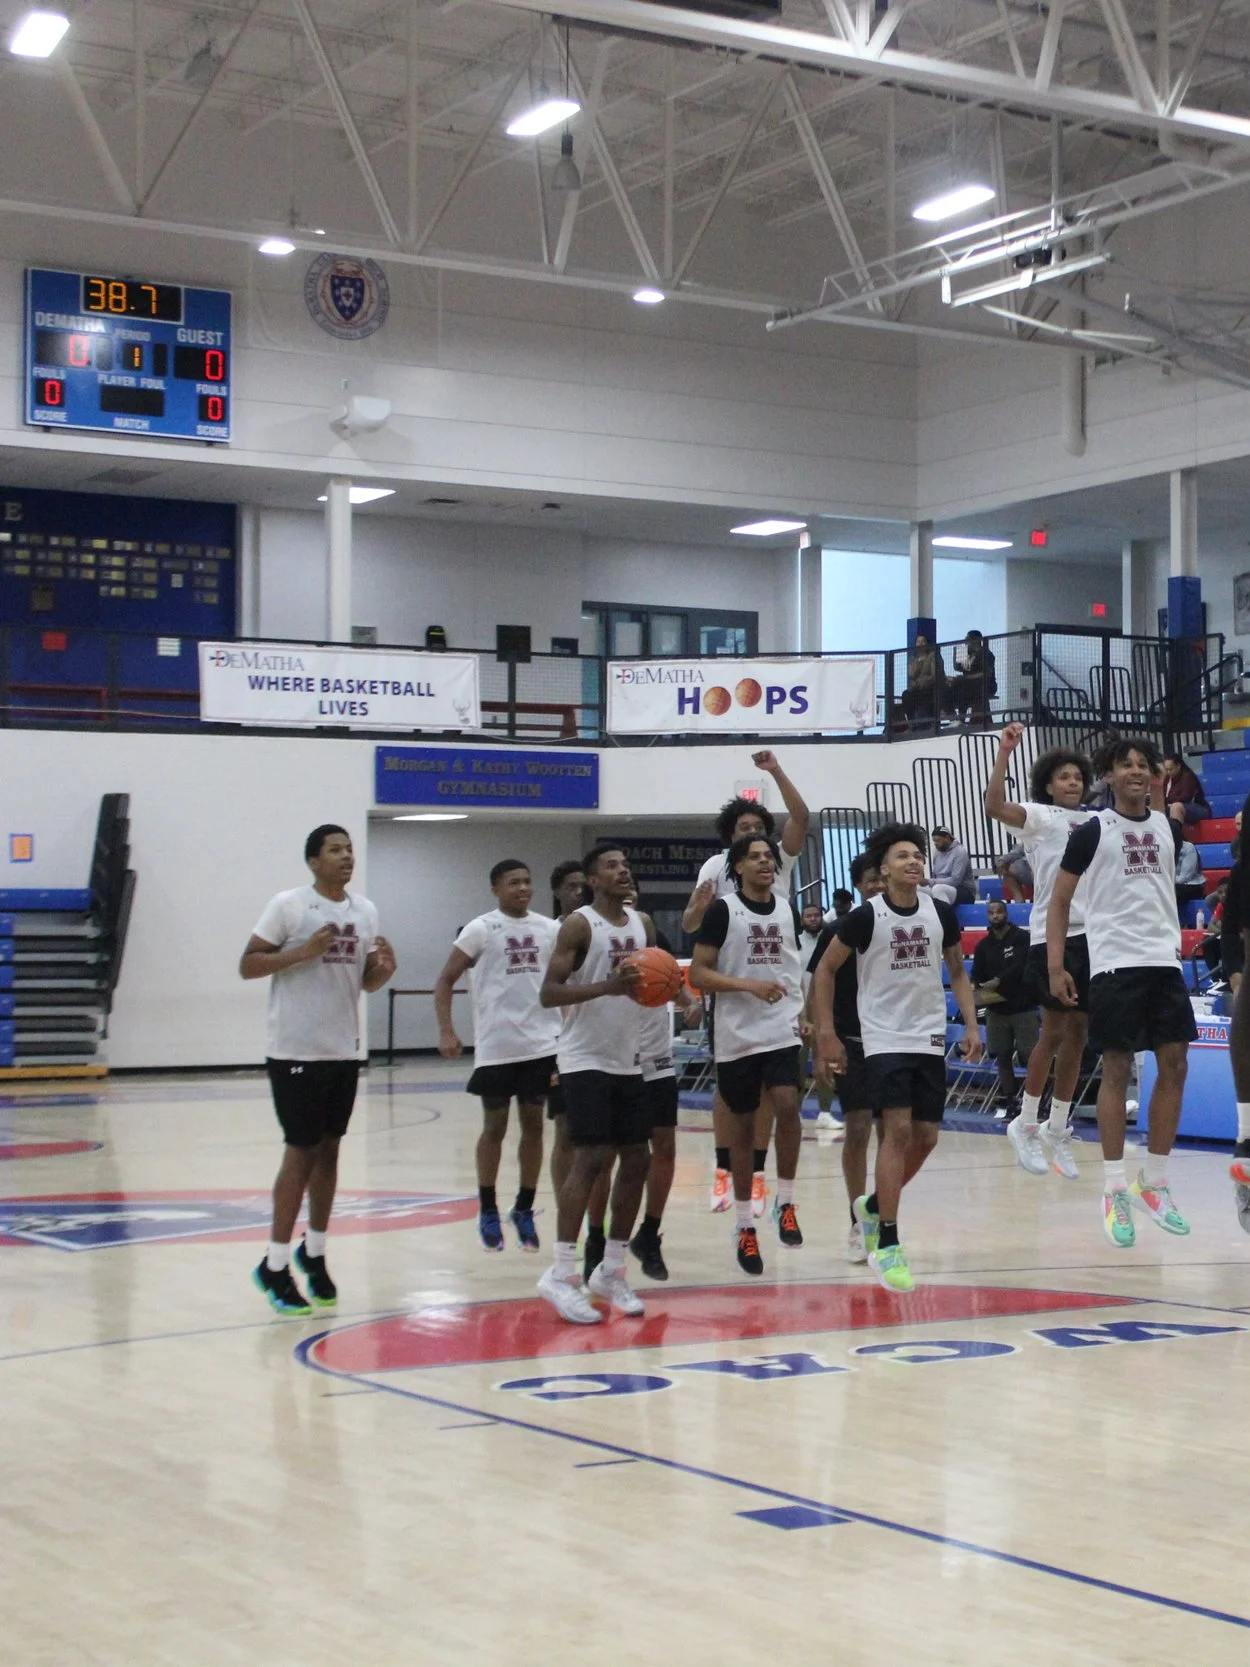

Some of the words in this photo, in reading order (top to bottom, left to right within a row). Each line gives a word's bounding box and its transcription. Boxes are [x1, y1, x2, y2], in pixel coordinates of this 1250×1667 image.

[89, 279, 158, 316] 38.7
[34, 311, 106, 333] DEMATHA
[115, 328, 151, 343] PERIOD
[177, 328, 224, 346] GUEST
[68, 334, 89, 367] 0
[132, 345, 141, 369] 1
[33, 367, 66, 380] FOULS
[205, 349, 224, 381] 0
[98, 374, 136, 387] PLAYER
[140, 376, 166, 390] FOUL
[196, 383, 227, 396] FOULS
[44, 379, 61, 405] 0
[34, 409, 67, 423] SCORE
[207, 396, 223, 421] 0
[197, 424, 228, 437] SCORE
[248, 674, 315, 694] WHERE
[320, 677, 436, 698] BASKETBALL
[318, 700, 369, 717] LIVES
[437, 780, 542, 797] GYMNASIUM
[1124, 866, 1162, 876] BASKETBALL
[891, 959, 931, 971] BASKETBALL
